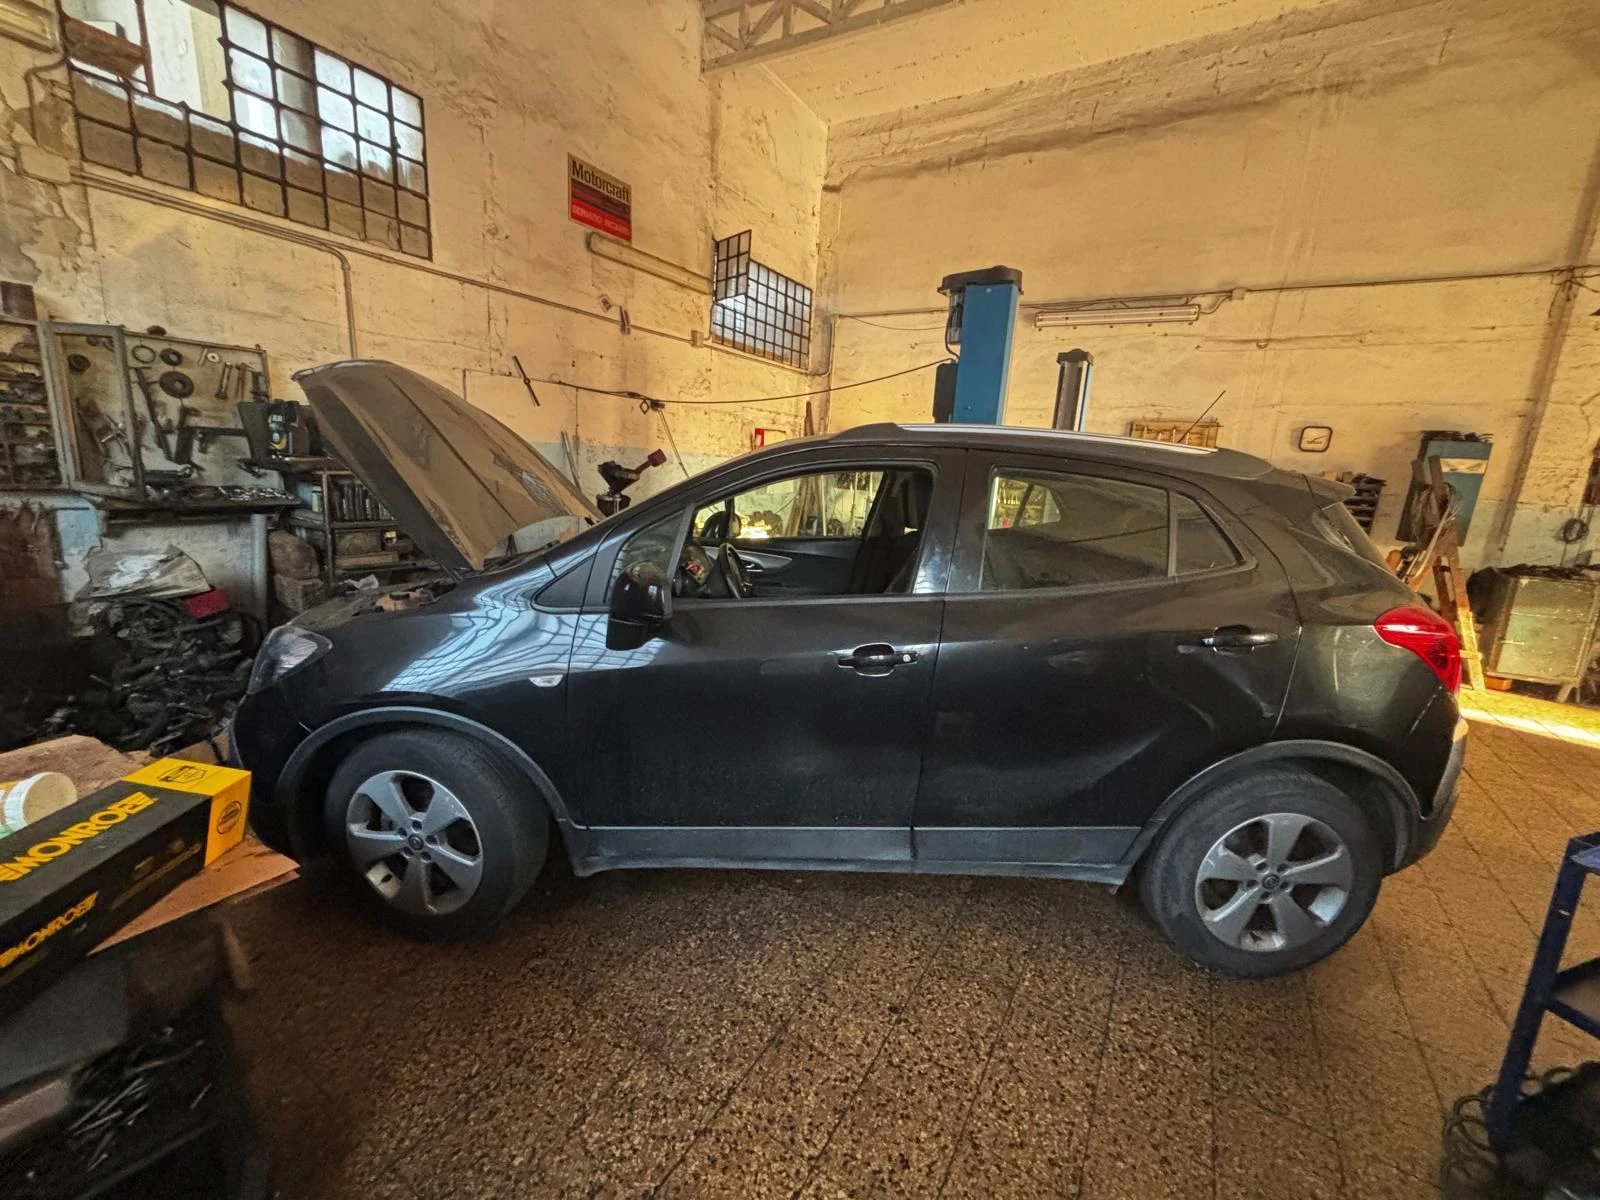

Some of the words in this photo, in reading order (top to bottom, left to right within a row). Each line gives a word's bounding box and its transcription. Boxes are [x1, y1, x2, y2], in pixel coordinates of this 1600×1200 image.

[571, 160, 629, 203] Motorcraft
[2, 791, 155, 879] MONROE
[6, 892, 97, 962] MONROE
